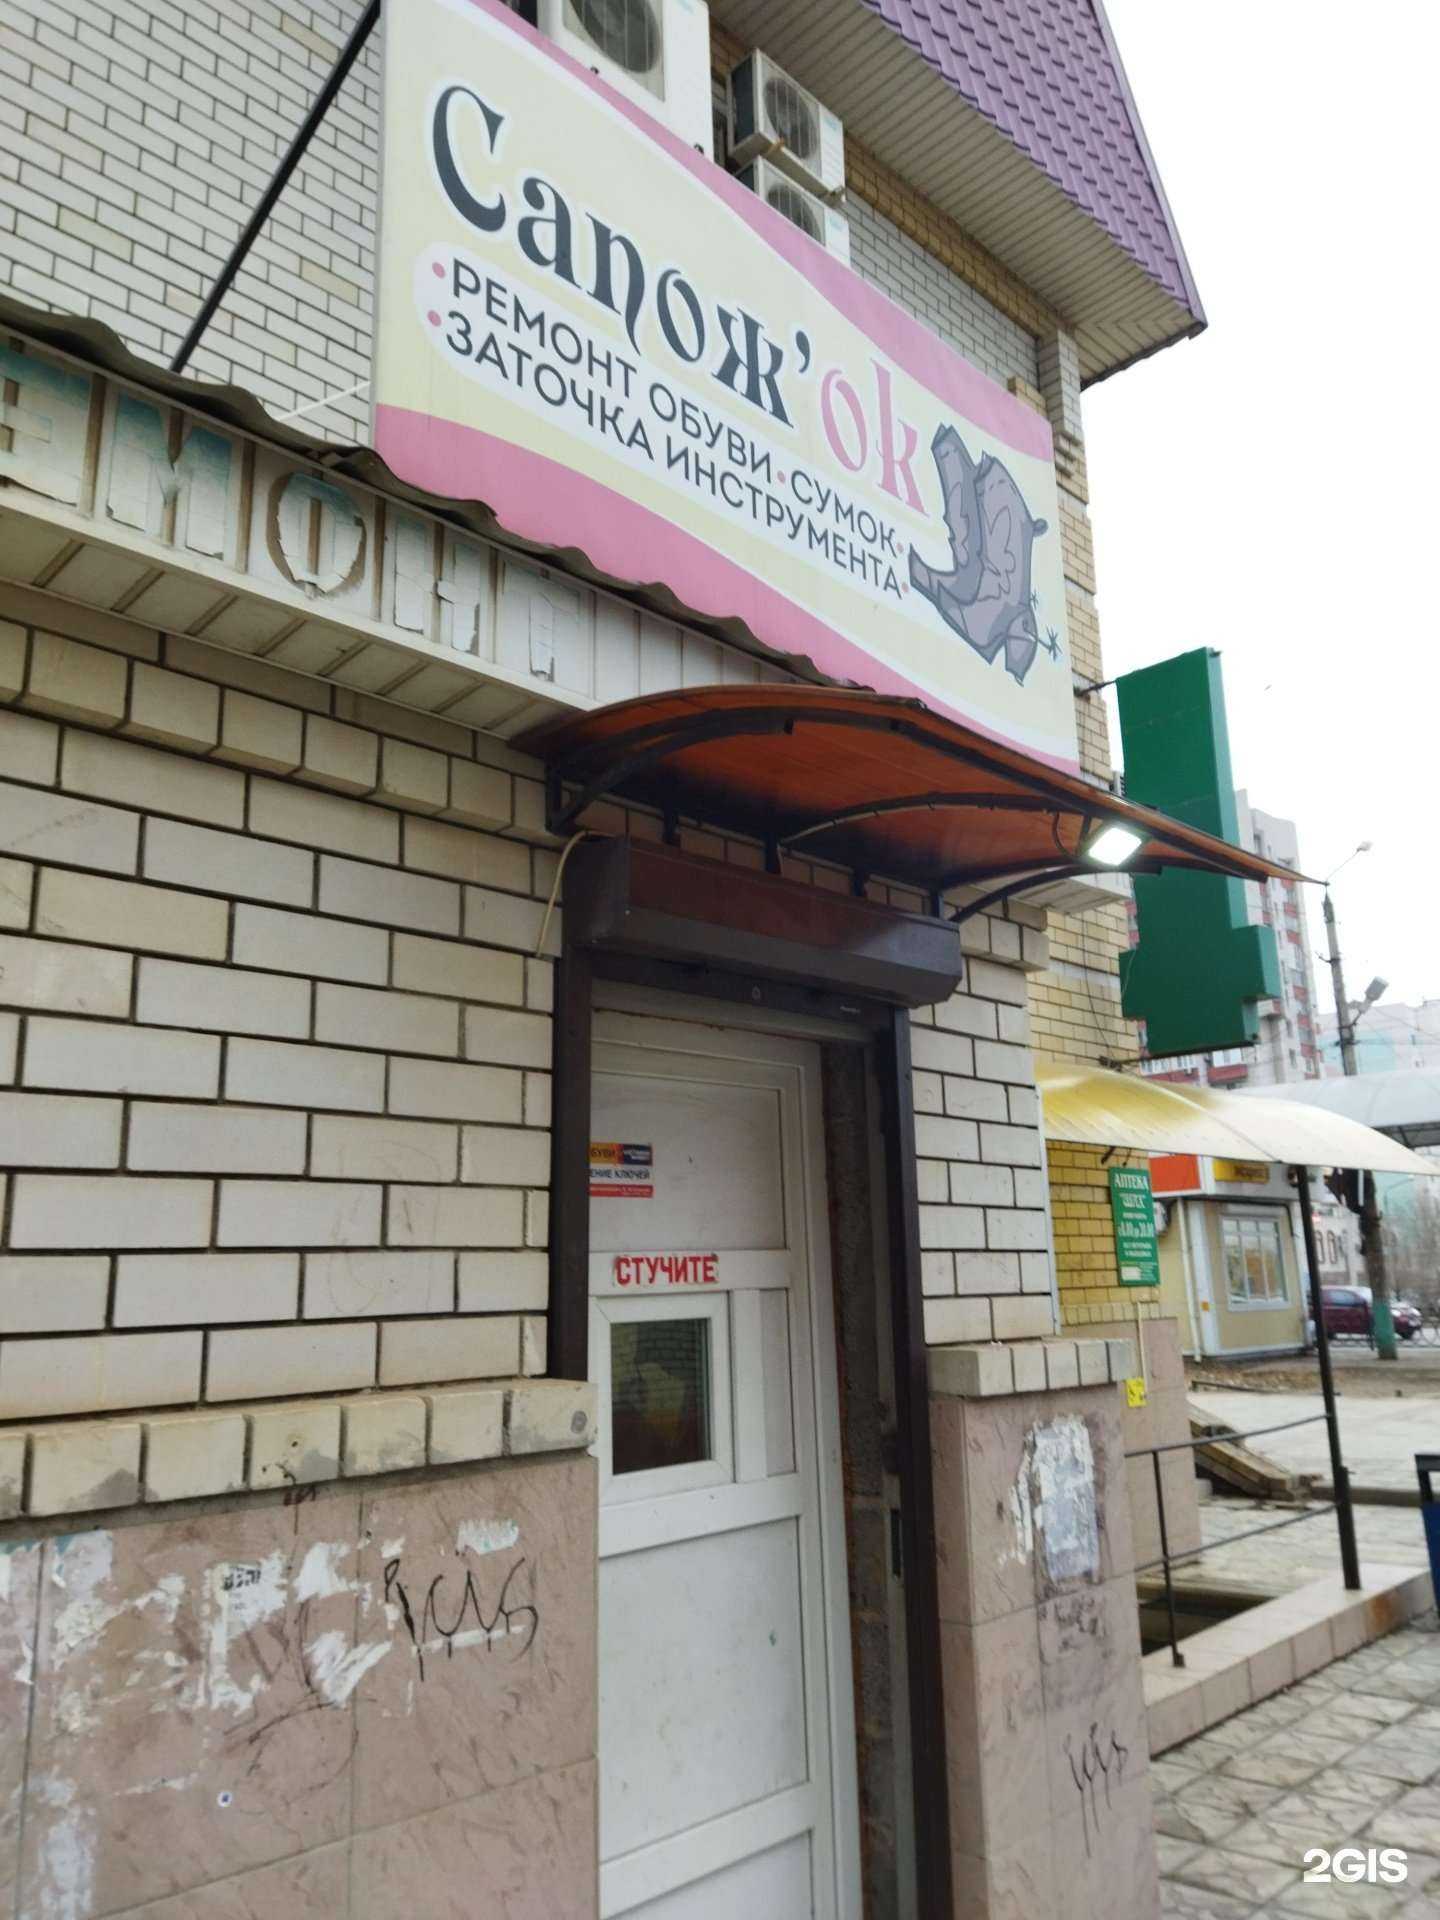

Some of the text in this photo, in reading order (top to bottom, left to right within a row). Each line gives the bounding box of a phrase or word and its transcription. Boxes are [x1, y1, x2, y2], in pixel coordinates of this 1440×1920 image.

[446, 310, 902, 599] ЗАТОЧКА ИНСТРУМЕНТА
[453, 257, 897, 557] РЕМОНТ ОБУВИ СУМОК
[1114, 1173, 1149, 1190] АПТЕКА
[615, 1254, 719, 1286] СТУЧИТЕ
